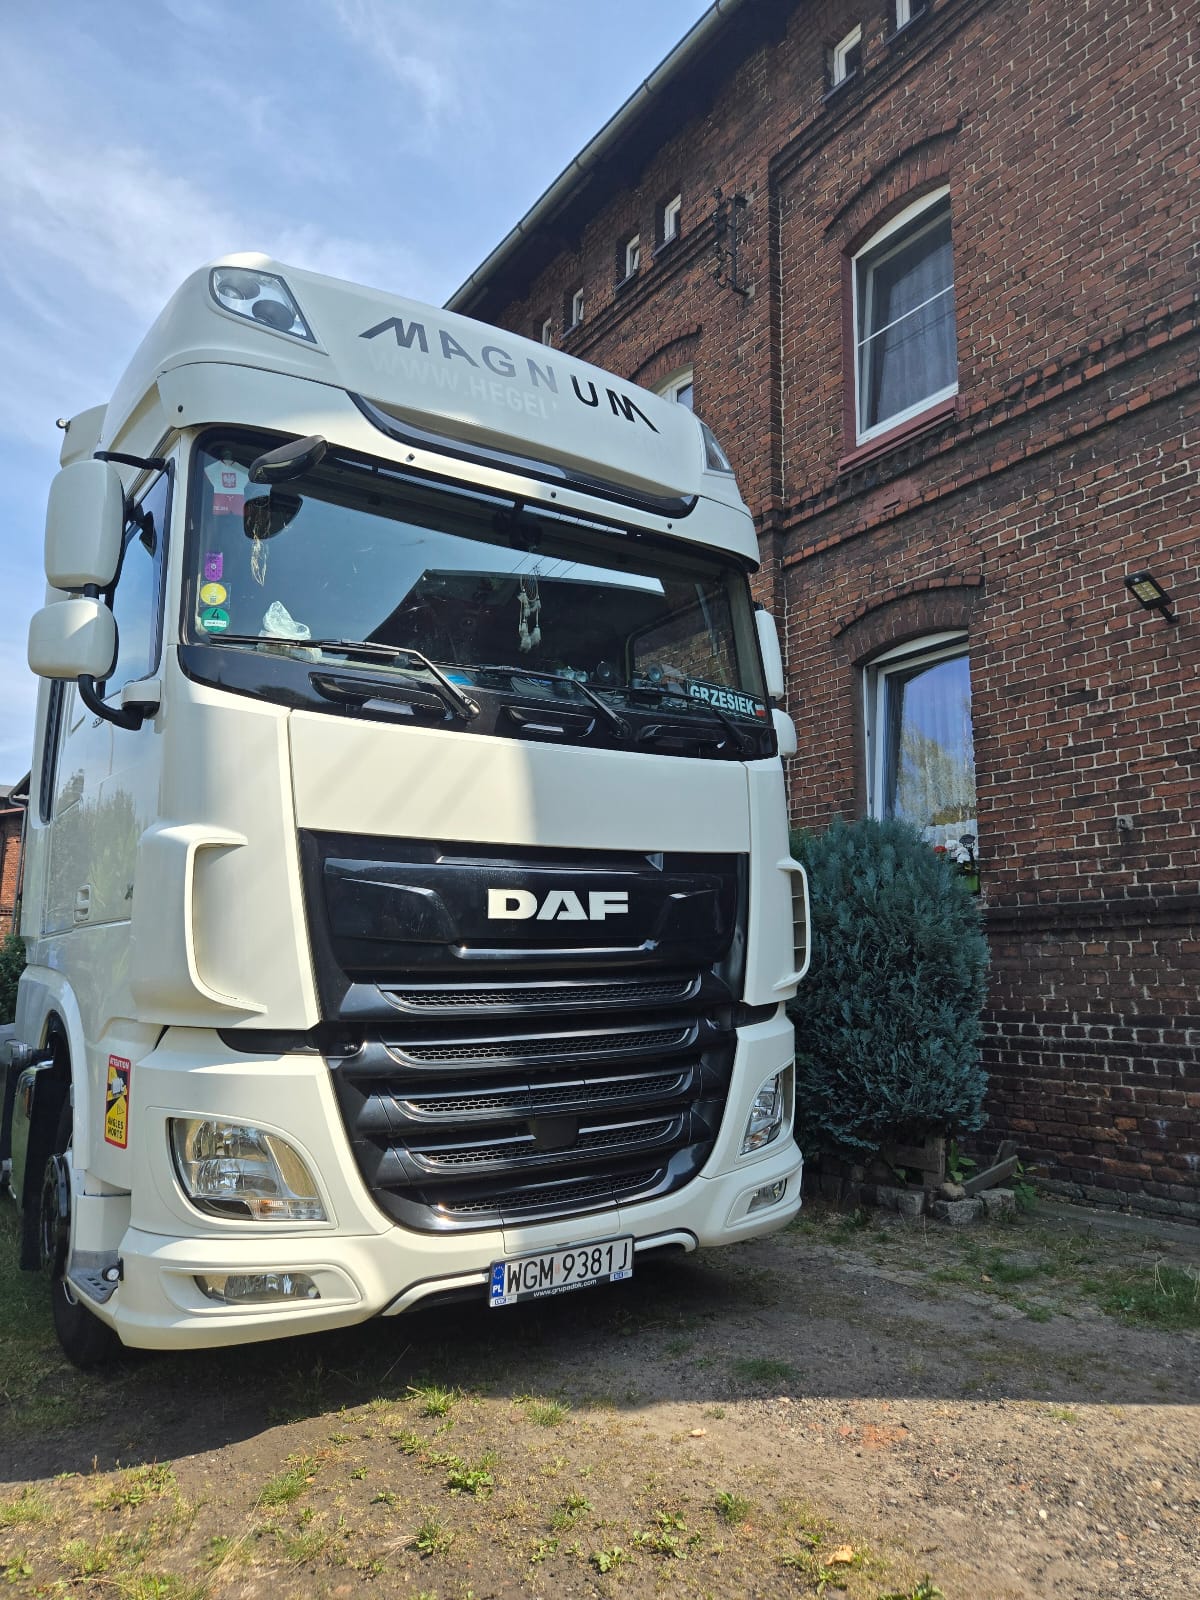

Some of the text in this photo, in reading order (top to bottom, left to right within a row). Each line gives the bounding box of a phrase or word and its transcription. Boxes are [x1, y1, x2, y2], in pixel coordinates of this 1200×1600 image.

[358, 316, 660, 434] MAGNUM
[368, 346, 557, 419] WWW.HEGEL
[211, 608, 220, 620] 4
[690, 685, 756, 716] GRZESIEK
[487, 888, 629, 921] DAF
[507, 1242, 628, 1293] WGM 9381J
[492, 1284, 502, 1293] PL
[533, 1279, 597, 1297] www.grupadbk.com
